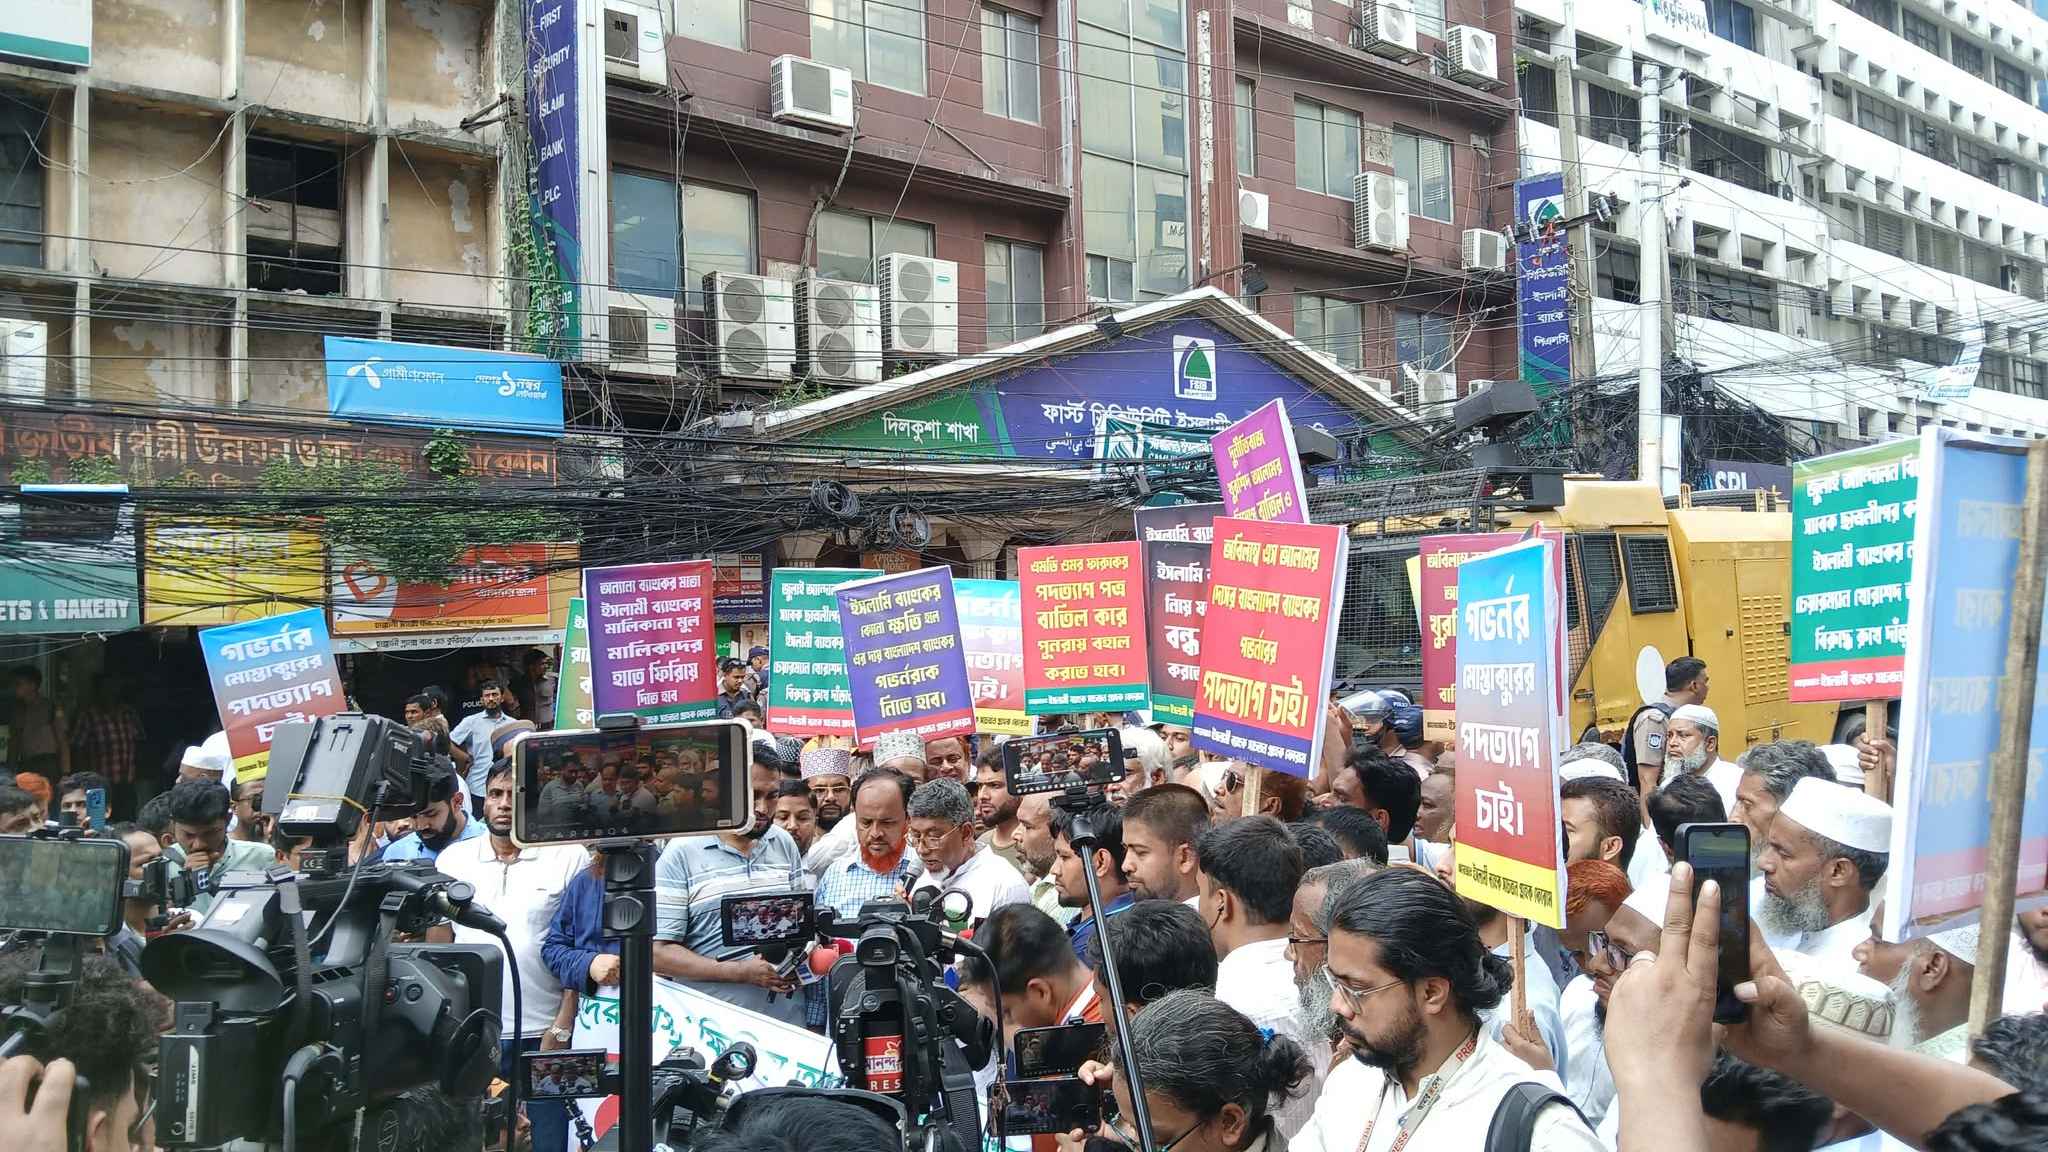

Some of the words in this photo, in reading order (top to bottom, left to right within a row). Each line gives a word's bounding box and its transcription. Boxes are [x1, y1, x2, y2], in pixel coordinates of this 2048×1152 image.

[540, 5, 562, 31] FIRST
[532, 45, 570, 78] SECURITY
[540, 93, 565, 118] ISLAMI
[541, 138, 564, 162] BANK
[543, 185, 561, 206] PLC
[382, 365, 445, 384] গ্রামীণফোন
[881, 411, 942, 444] দিলকুশা
[944, 421, 980, 444] শাখা
[1031, 556, 1058, 573] এমডি
[1156, 561, 1203, 583] ইসলামি
[639, 578, 676, 592] ব্যাংকের
[1036, 581, 1095, 601] পদত্যাগ
[1100, 580, 1126, 598] পত্র
[38, 600, 49, 620] &
[54, 598, 129, 620] BAKERY
[601, 598, 648, 617] ইসলামী
[651, 598, 702, 614] ব্যাংকের
[849, 590, 893, 617] ইসলামি
[894, 584, 942, 607] ব্যাংকের
[1465, 574, 1530, 645] গভর্নর
[605, 618, 673, 634] মালিকানা
[676, 616, 700, 633] মূল
[887, 609, 922, 635] ক্ষতি
[1036, 604, 1088, 629] বাতিল
[220, 623, 313, 661] গভর্নর
[853, 653, 867, 666] এর
[921, 635, 955, 654] ব্যাংকের
[1091, 636, 1130, 649] বহাল
[227, 679, 333, 715] পদত্যাগ
[1203, 671, 1267, 721] পদত্যাগ
[1268, 675, 1309, 727] চাই।
[1461, 721, 1540, 769] পদত্যাগ
[1474, 780, 1524, 836] চাই।
